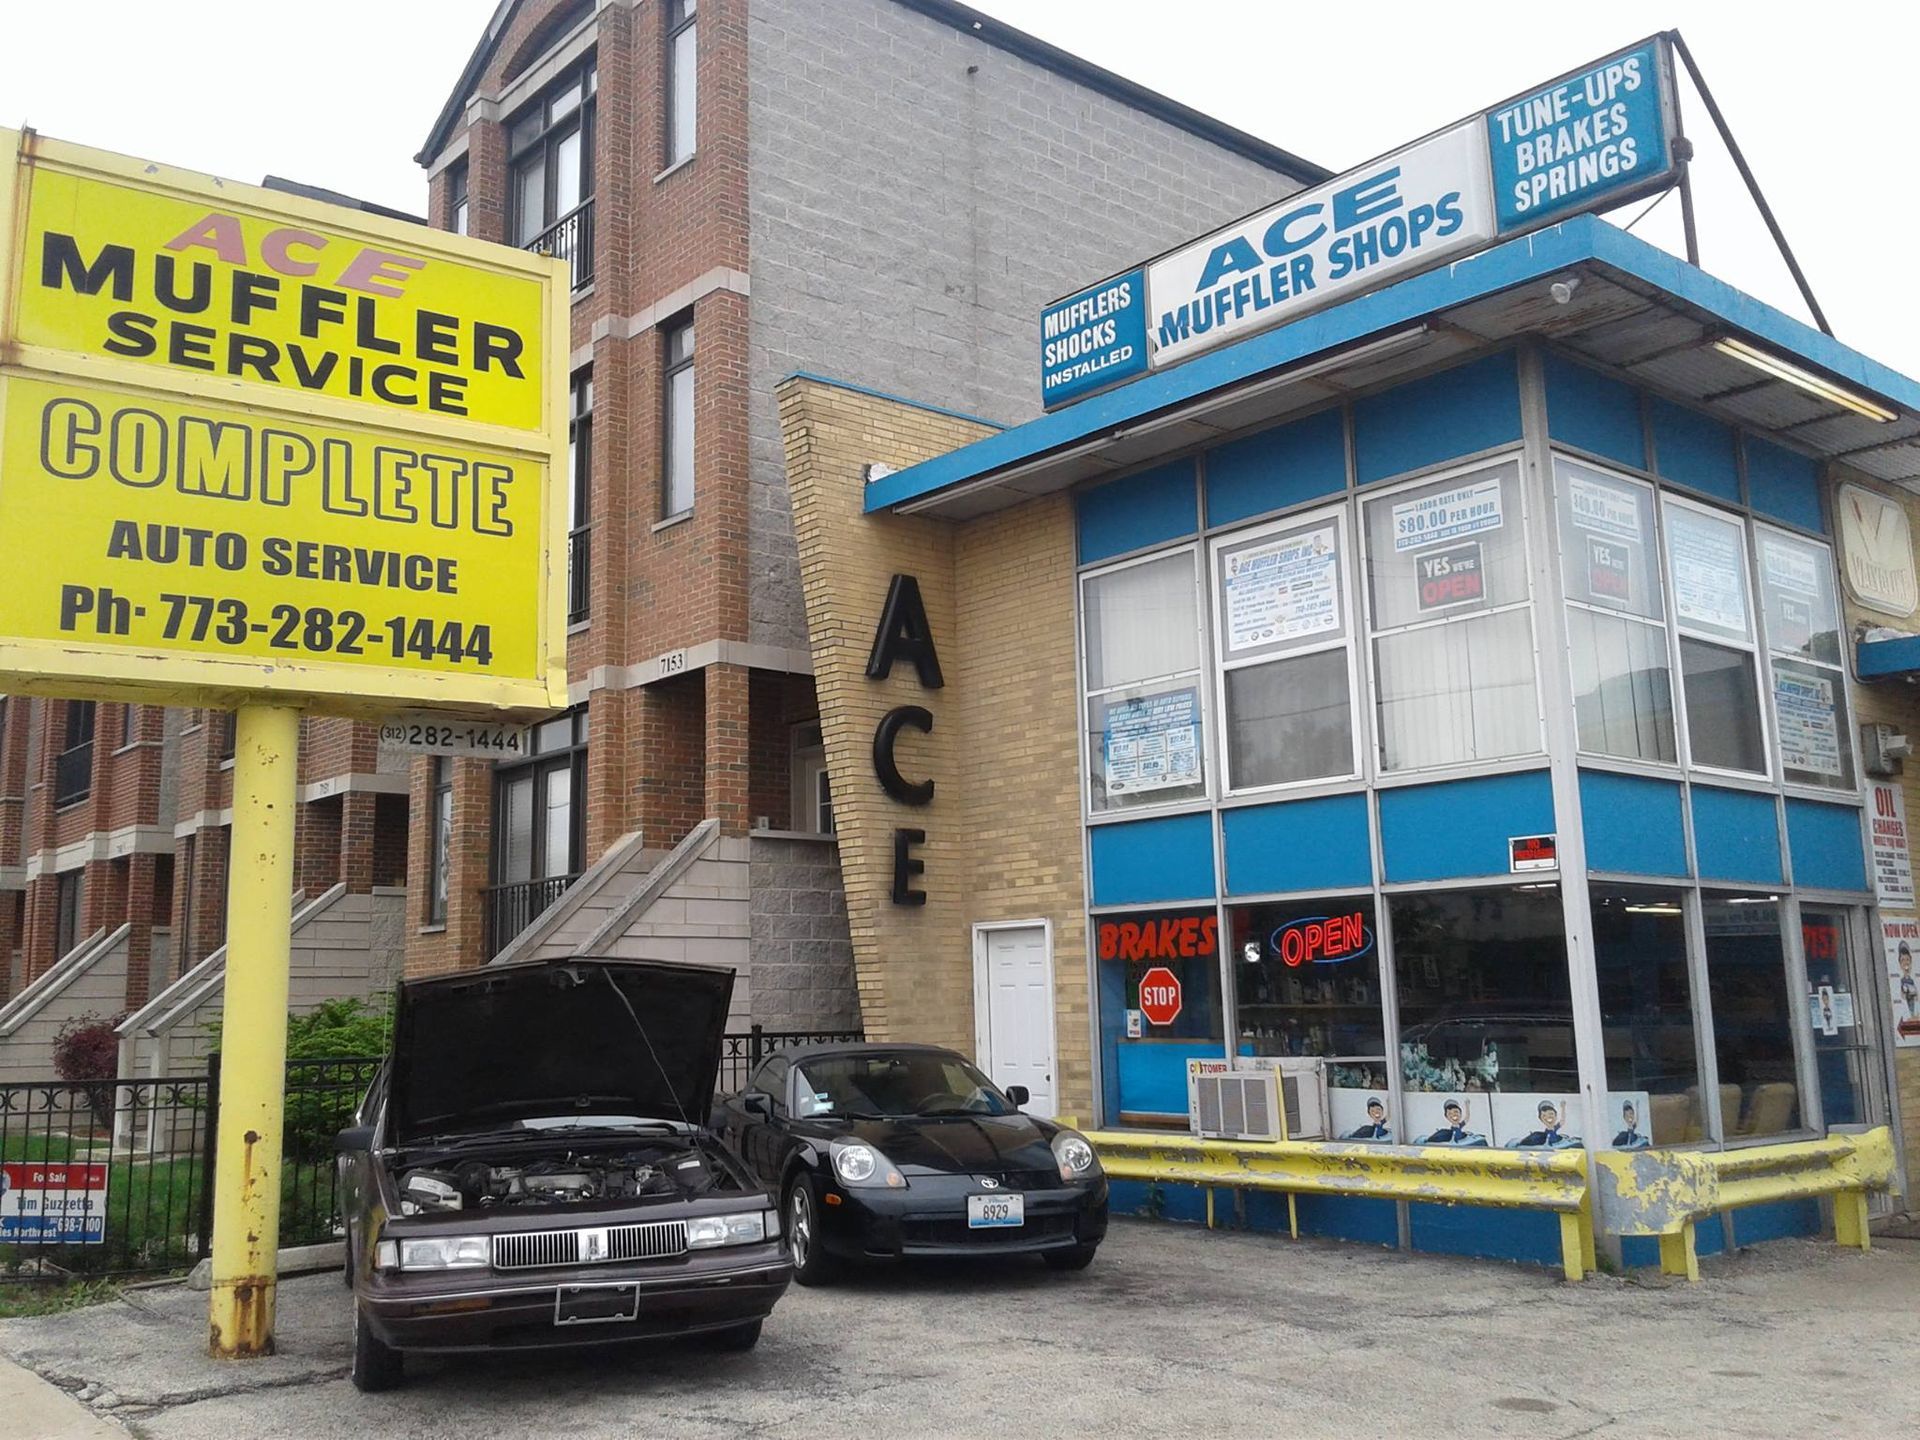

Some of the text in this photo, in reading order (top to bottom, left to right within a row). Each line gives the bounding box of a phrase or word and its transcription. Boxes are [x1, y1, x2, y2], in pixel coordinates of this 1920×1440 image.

[1497, 57, 1642, 143] TUNE-UPS
[1515, 102, 1628, 175] BRAKES
[1513, 138, 1638, 212] SPRINGS
[1193, 165, 1402, 292] ACE
[163, 212, 428, 298] ACE
[1157, 191, 1464, 347] MUFFLER SHOPS
[41, 231, 526, 379] MUFFLER
[1043, 282, 1132, 340] MUFFLERS
[103, 310, 469, 416] SERVICE
[1043, 323, 1117, 368] SHOCKS
[1045, 344, 1133, 389] INSTALLED
[40, 397, 514, 538] COMPLETE
[1398, 502, 1495, 534] $80.00 PER HOUR
[107, 520, 458, 595] AUTO SERVICE
[1423, 556, 1451, 578] YES
[1423, 572, 1480, 606] OPEN
[160, 594, 493, 666] 773-282-1444
[661, 653, 683, 674] 7153
[380, 724, 519, 751] (312) 282-1444
[1874, 786, 1896, 818] OIL
[1527, 838, 1540, 849] NO
[1872, 818, 1904, 837] CHANGES
[1100, 915, 1218, 962] BRAKES
[1281, 912, 1363, 967] OPEN
[1883, 923, 1919, 938] NOW OPEN
[1144, 986, 1176, 1006] STOP
[1190, 1063, 1227, 1074] CSTOMER
[33, 1172, 46, 1183] Fo
[983, 1204, 1008, 1220] 8929
